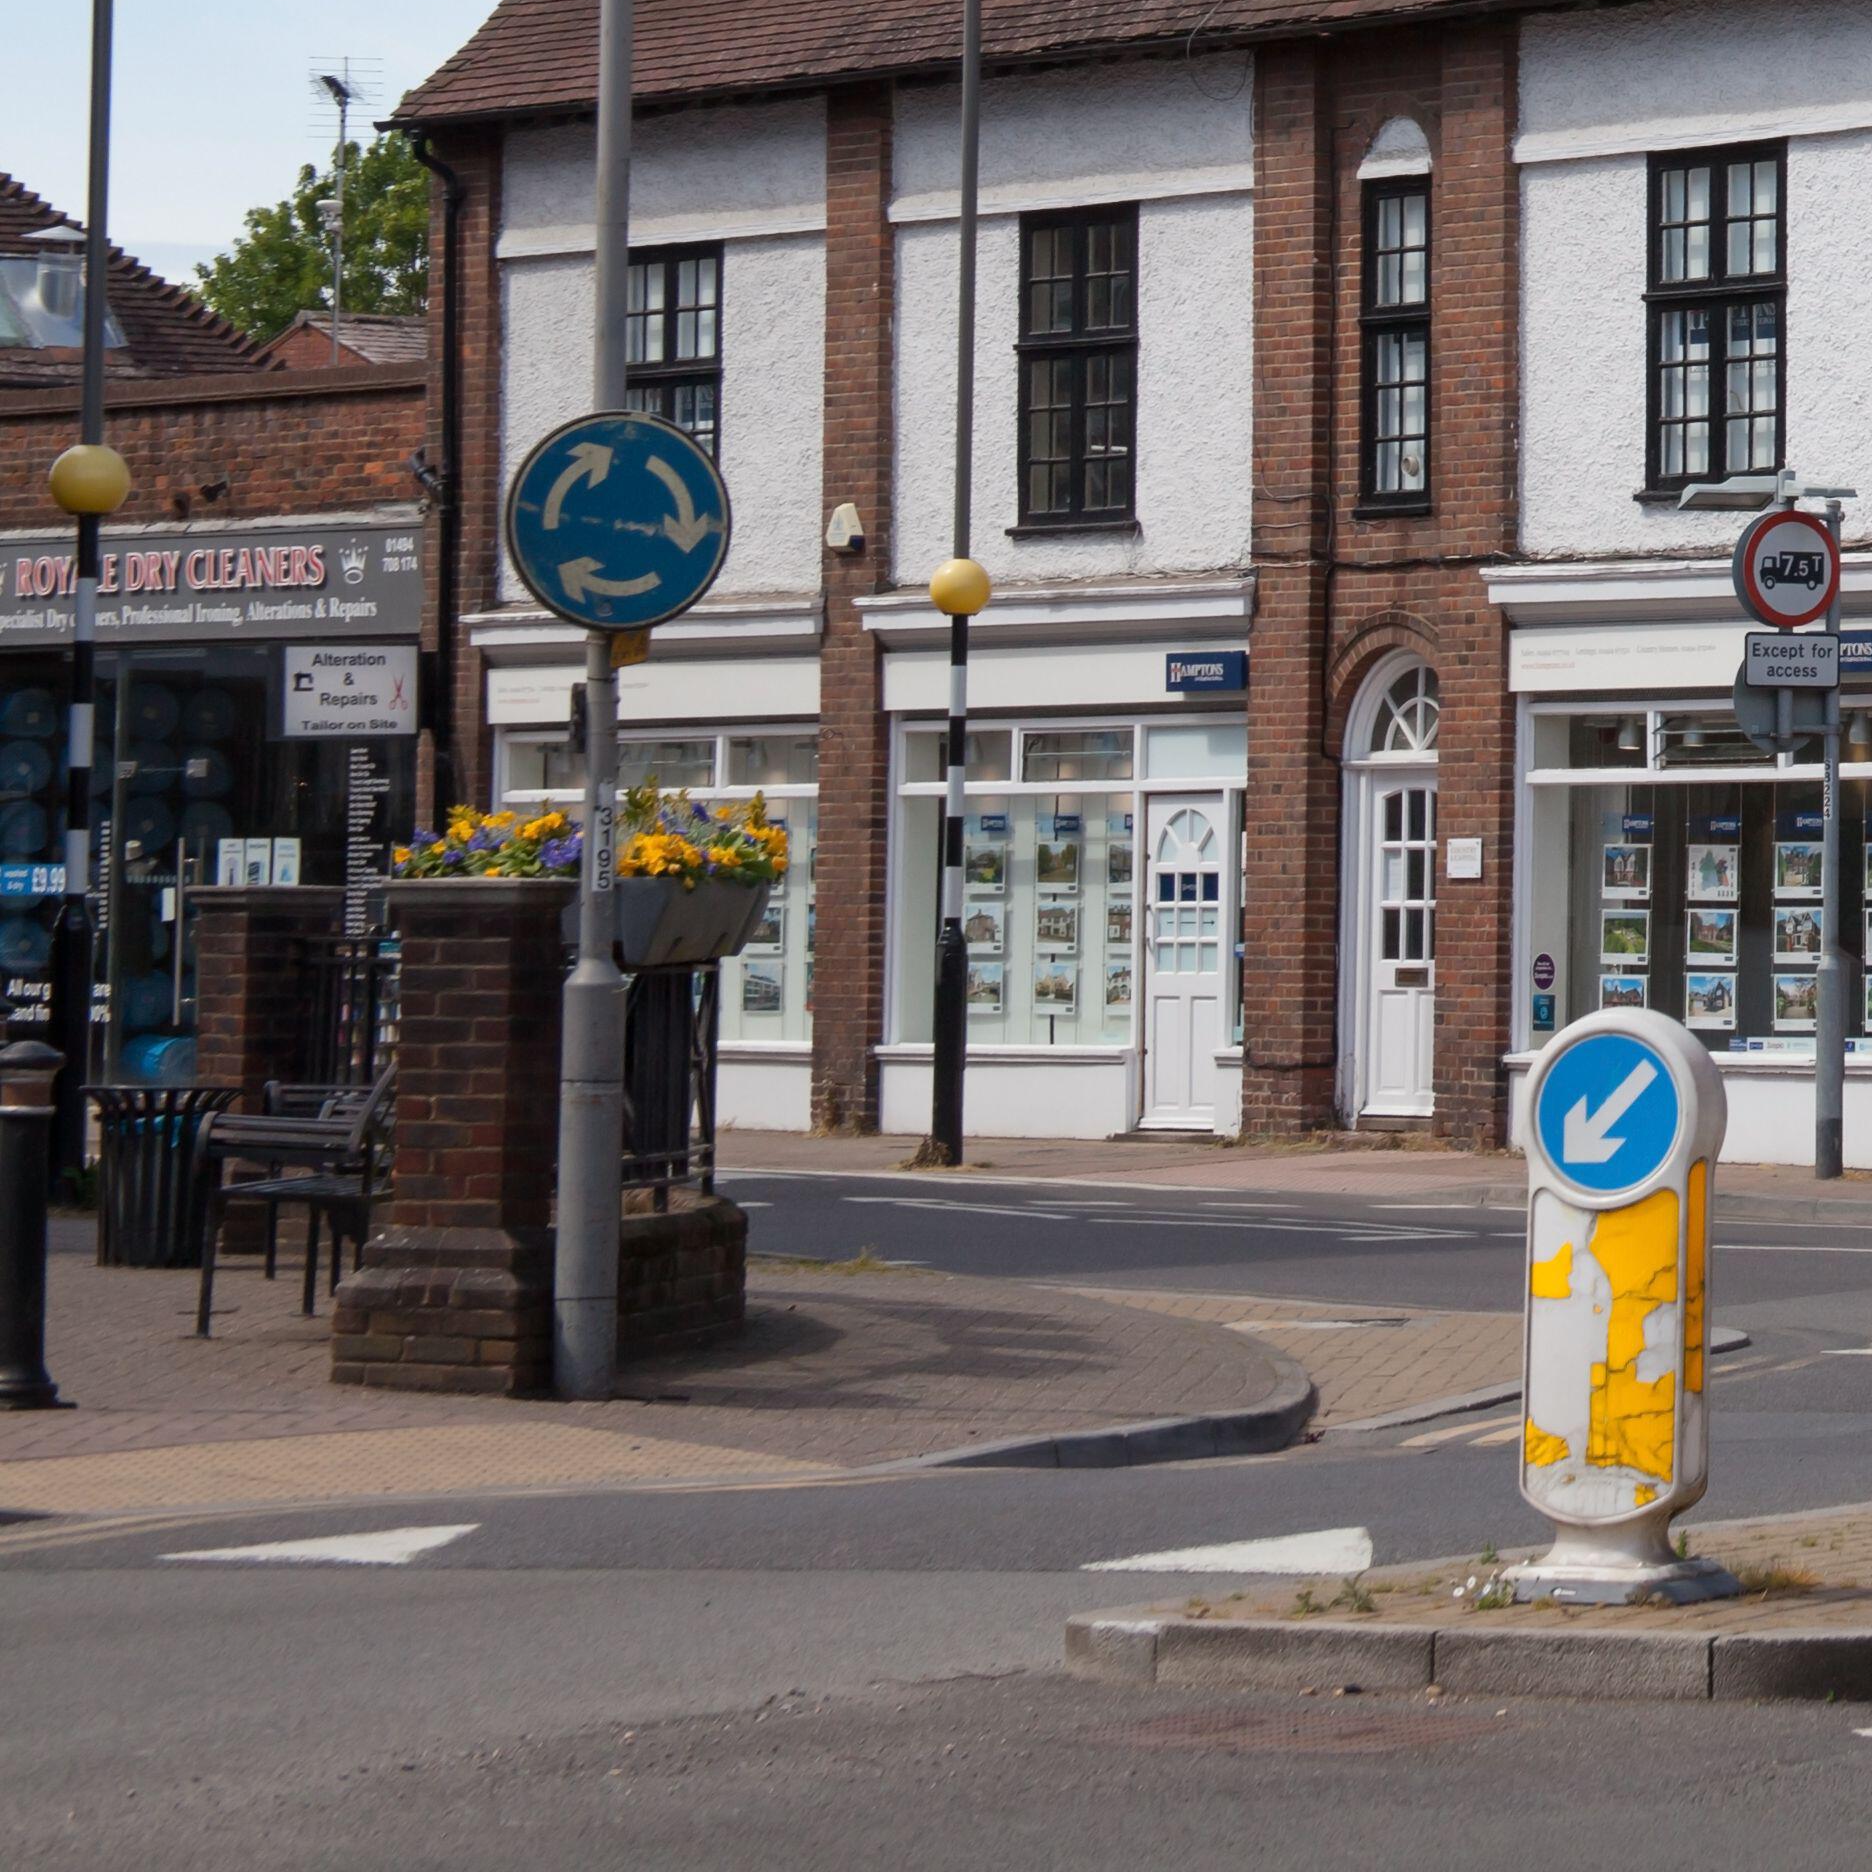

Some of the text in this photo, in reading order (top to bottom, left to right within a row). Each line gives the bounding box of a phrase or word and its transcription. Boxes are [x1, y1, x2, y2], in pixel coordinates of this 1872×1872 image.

[125, 550, 181, 591] DRY
[185, 544, 326, 590] CLEANERS
[0, 609, 44, 631] pecialist
[46, 609, 68, 632] Dry
[121, 604, 193, 626] Professional
[246, 600, 313, 621] Alterations
[314, 598, 327, 619] &
[328, 596, 378, 622] Repairs
[1752, 643, 1833, 660] Except for
[1840, 642, 1872, 657] PTONS
[312, 652, 386, 667] Alteration
[343, 672, 354, 686] &
[1170, 662, 1224, 683] HAMPTONS
[1767, 665, 1818, 678] access
[320, 692, 378, 708] Repairs
[302, 719, 398, 730] Tailor on Site
